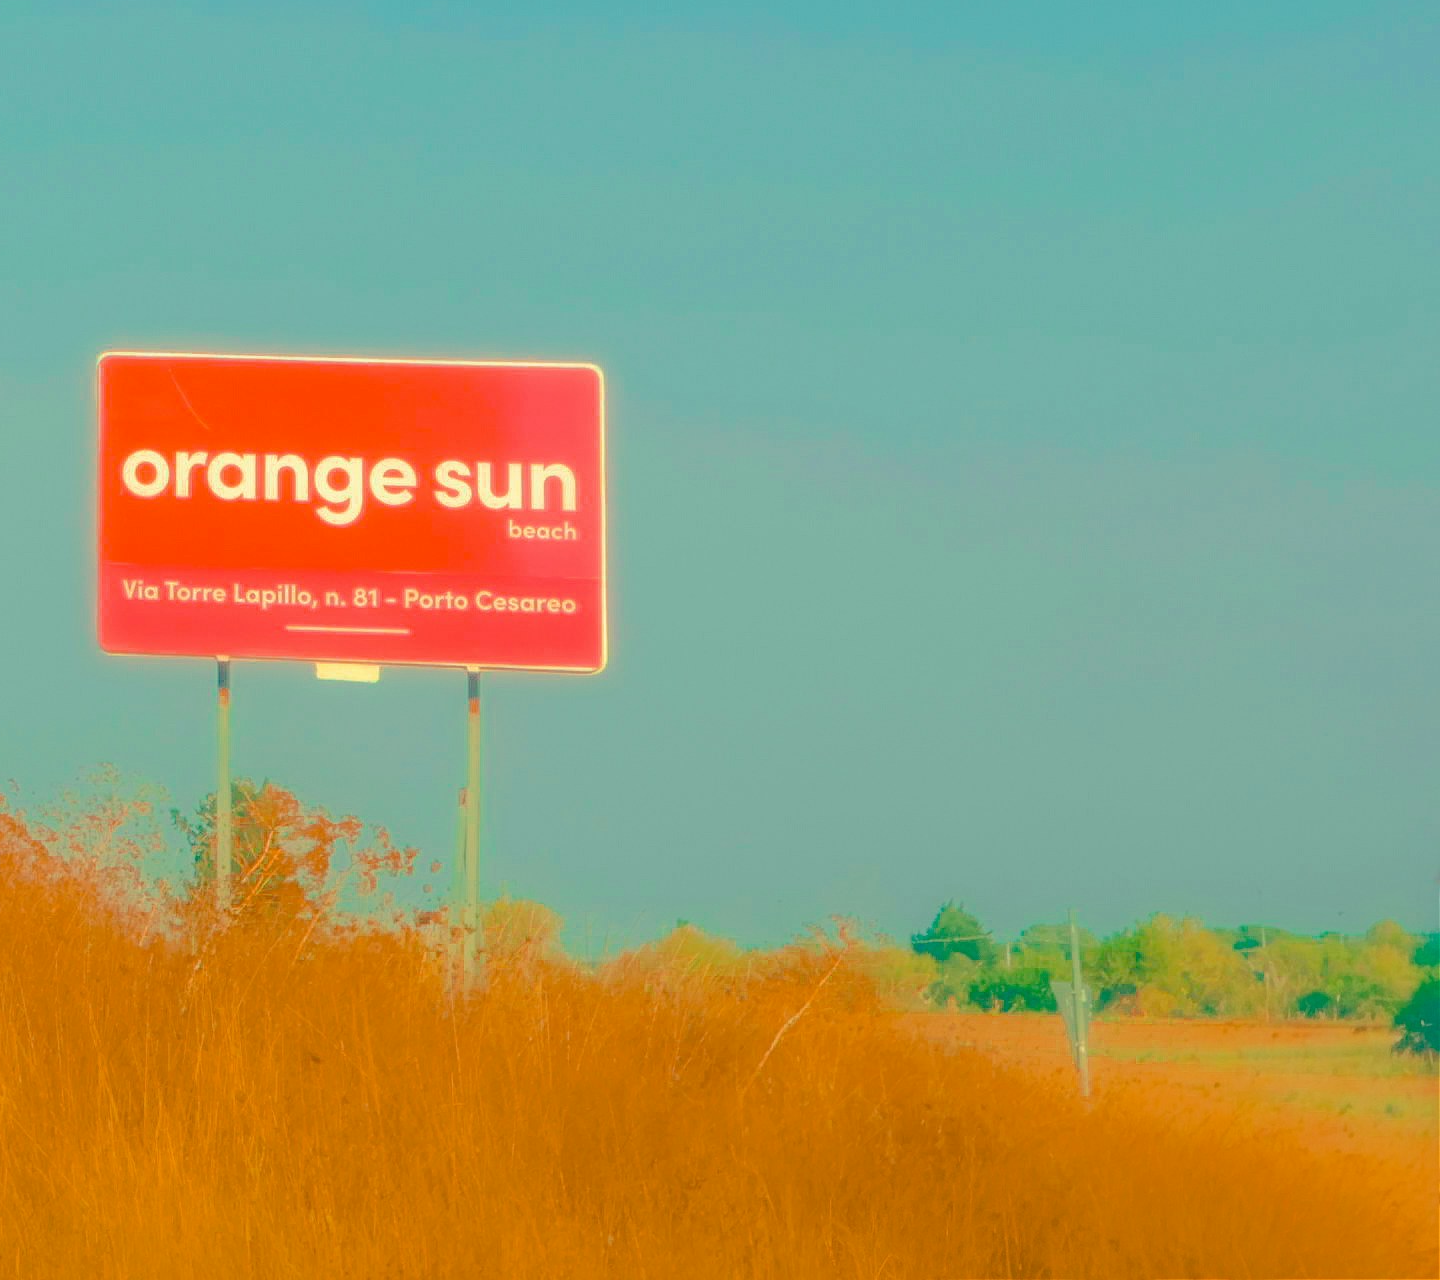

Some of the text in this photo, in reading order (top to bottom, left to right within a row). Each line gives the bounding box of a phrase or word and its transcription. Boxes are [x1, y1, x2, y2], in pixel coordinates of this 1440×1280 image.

[122, 448, 578, 526] orange sun
[508, 520, 577, 541] beach
[122, 579, 159, 601] Via
[164, 580, 226, 603] Torre
[233, 583, 319, 610] Lapillo,
[325, 591, 346, 608] n.
[353, 589, 379, 608] 81
[403, 589, 469, 610] Porto
[475, 591, 577, 614] Cesareo
